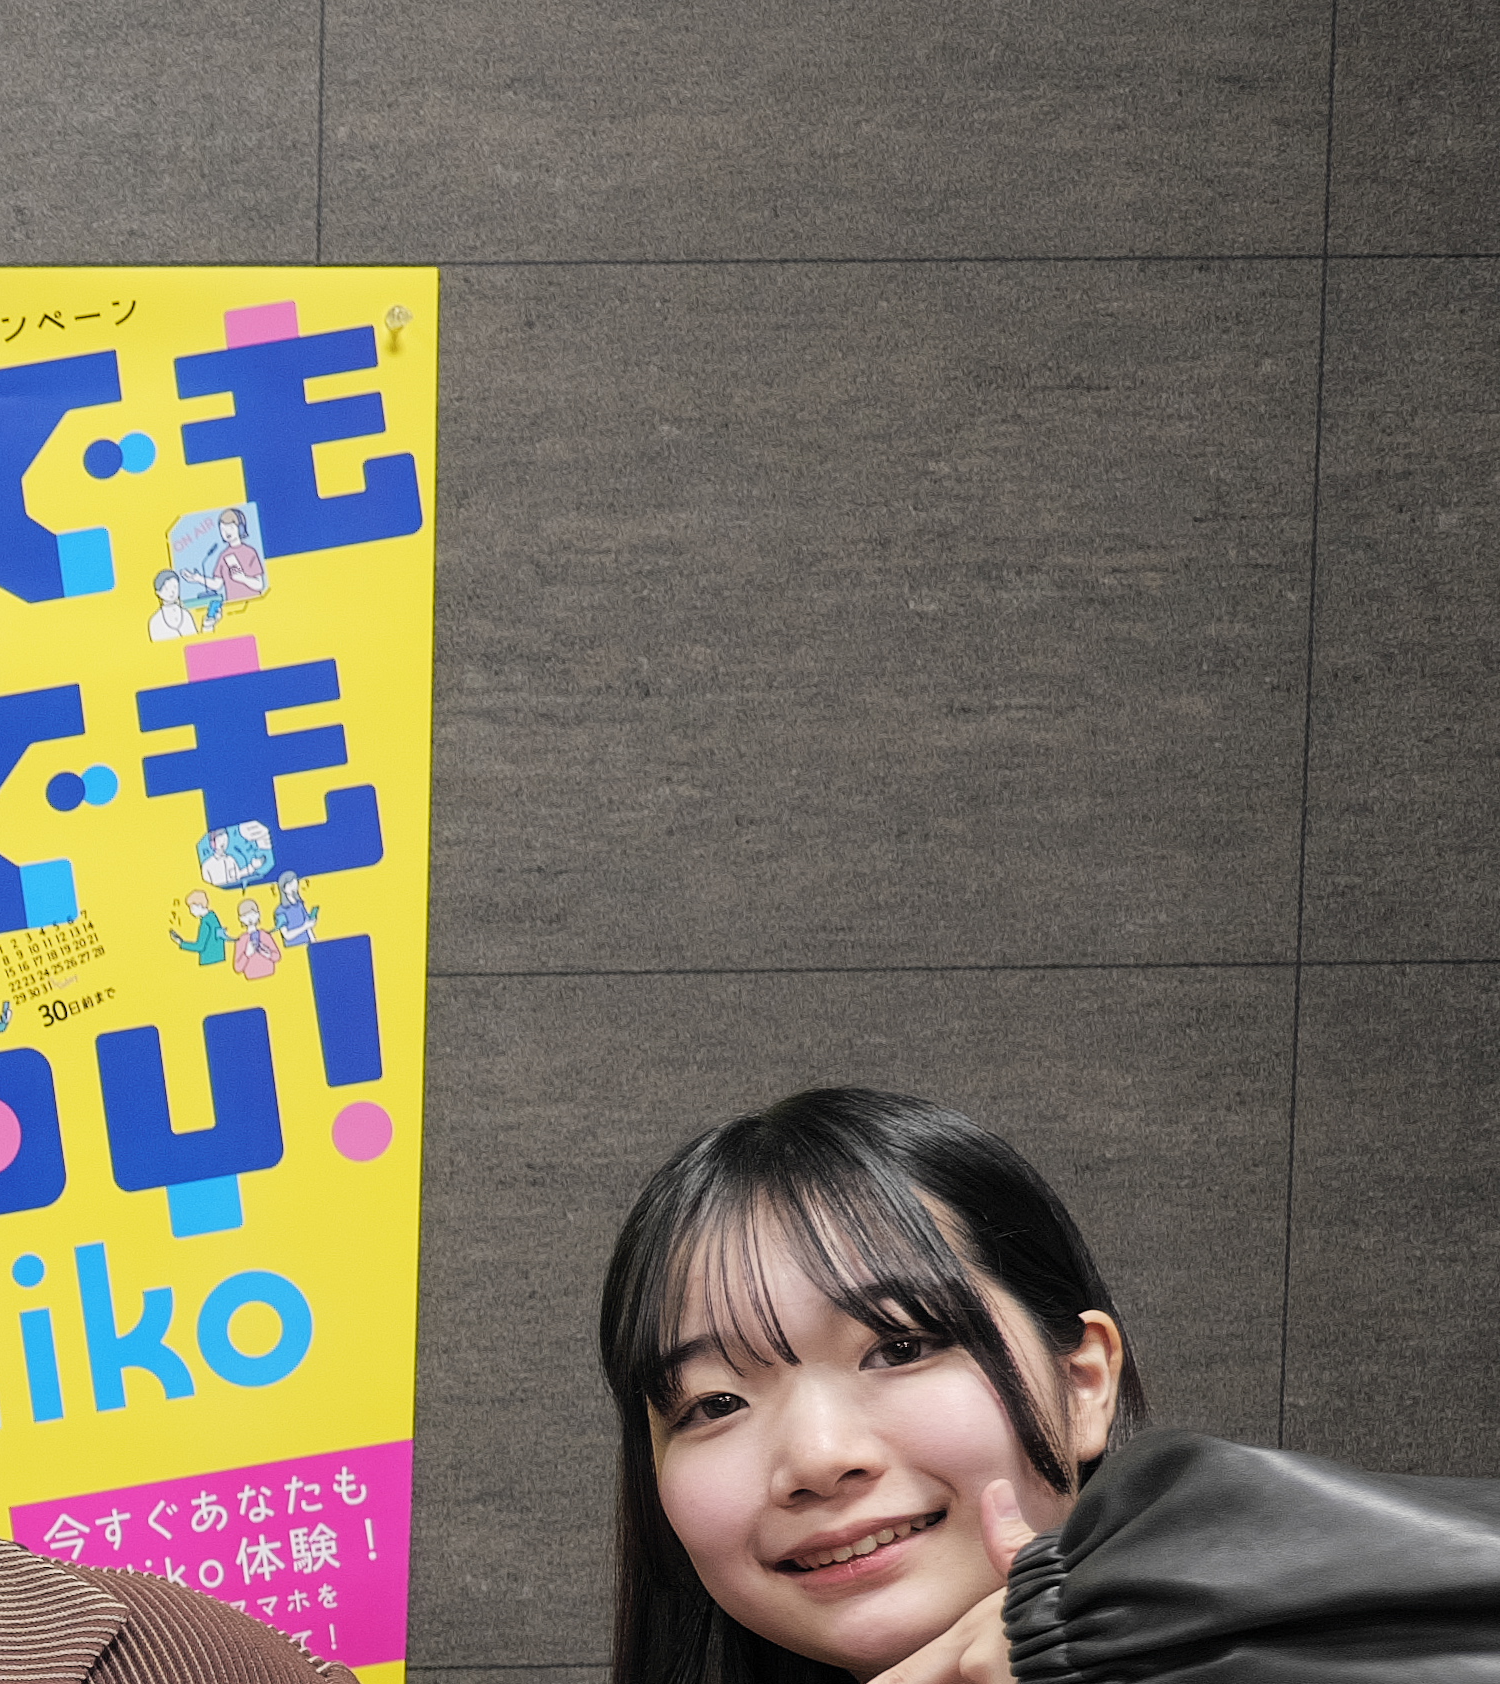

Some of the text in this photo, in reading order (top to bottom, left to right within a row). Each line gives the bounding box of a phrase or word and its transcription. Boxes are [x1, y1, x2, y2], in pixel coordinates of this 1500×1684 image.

[38, 986, 116, 1028] 30日前まで
[44, 1467, 367, 1559] 今すぐあなたも
